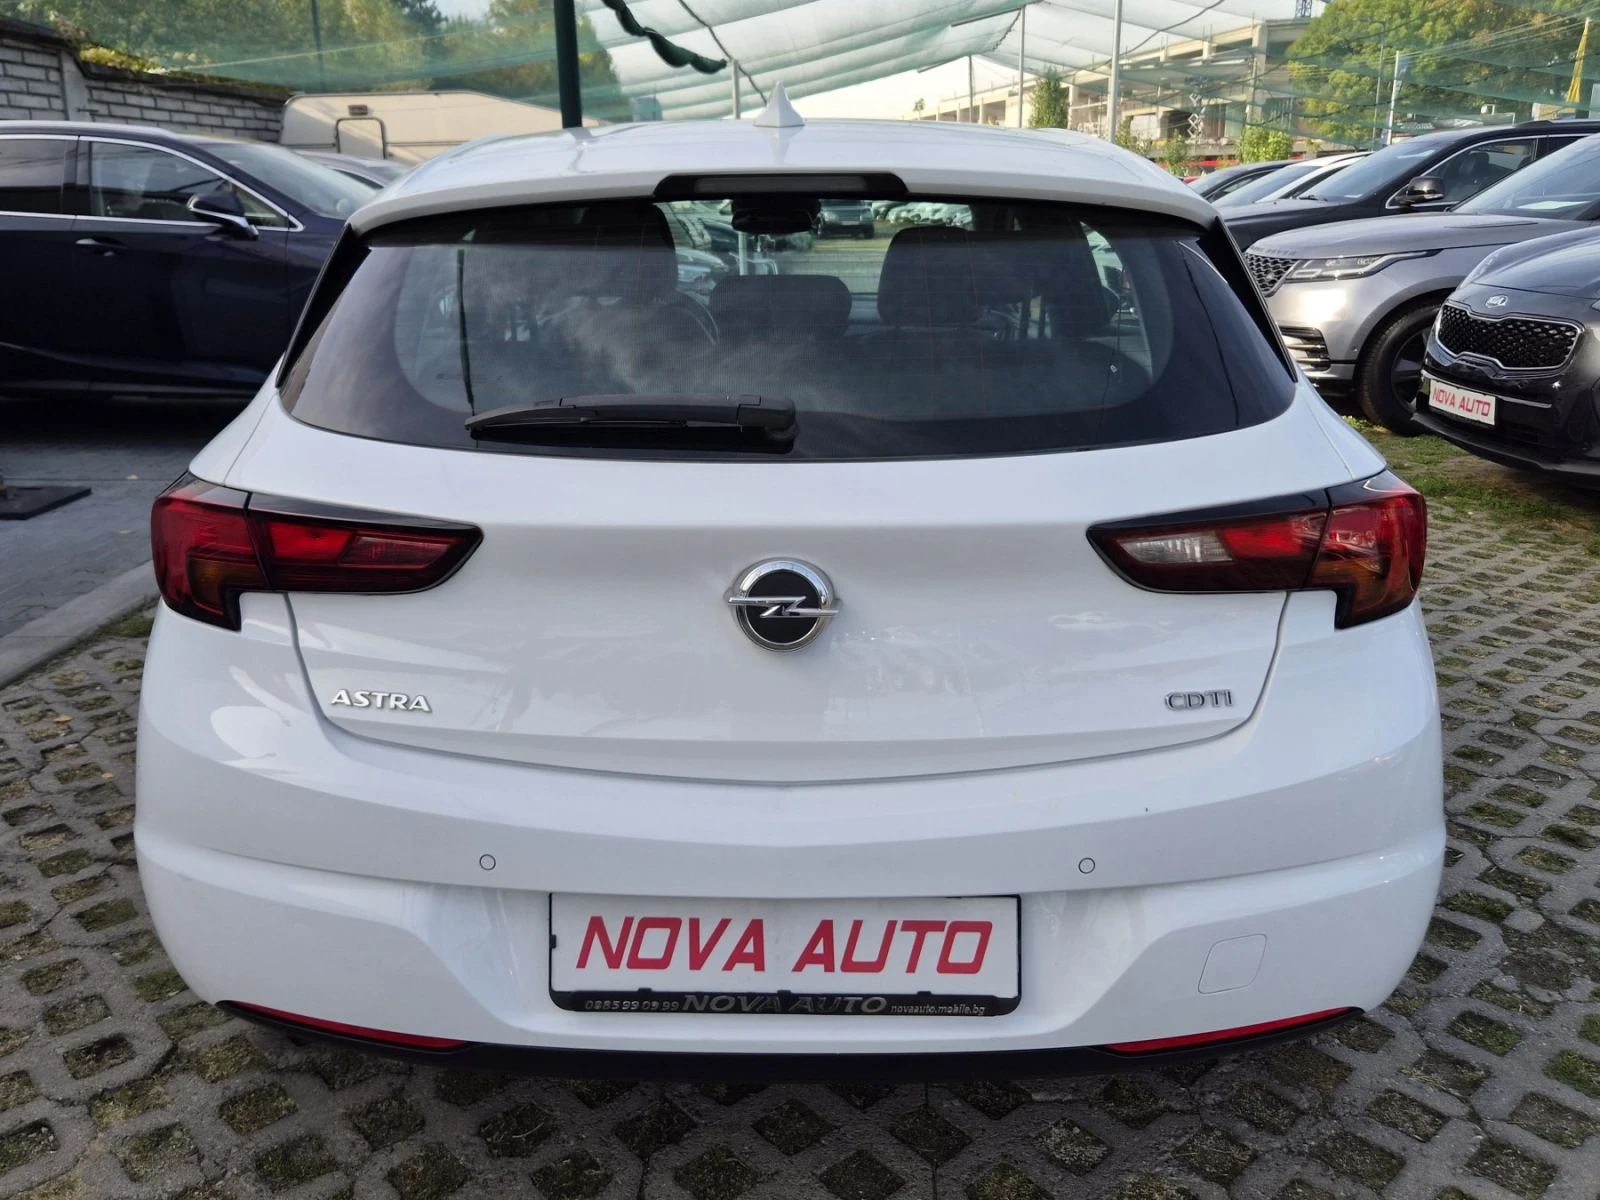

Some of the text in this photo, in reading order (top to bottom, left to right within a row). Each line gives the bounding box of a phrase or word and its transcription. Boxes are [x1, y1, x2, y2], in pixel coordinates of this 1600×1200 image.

[1432, 386, 1492, 418] NOVA AUTO
[330, 688, 433, 713] ASTRA
[1164, 689, 1234, 711] CDTI
[576, 915, 994, 975] NOVA AUTO
[682, 994, 781, 1012] NOVA
[788, 996, 887, 1014] AUTO
